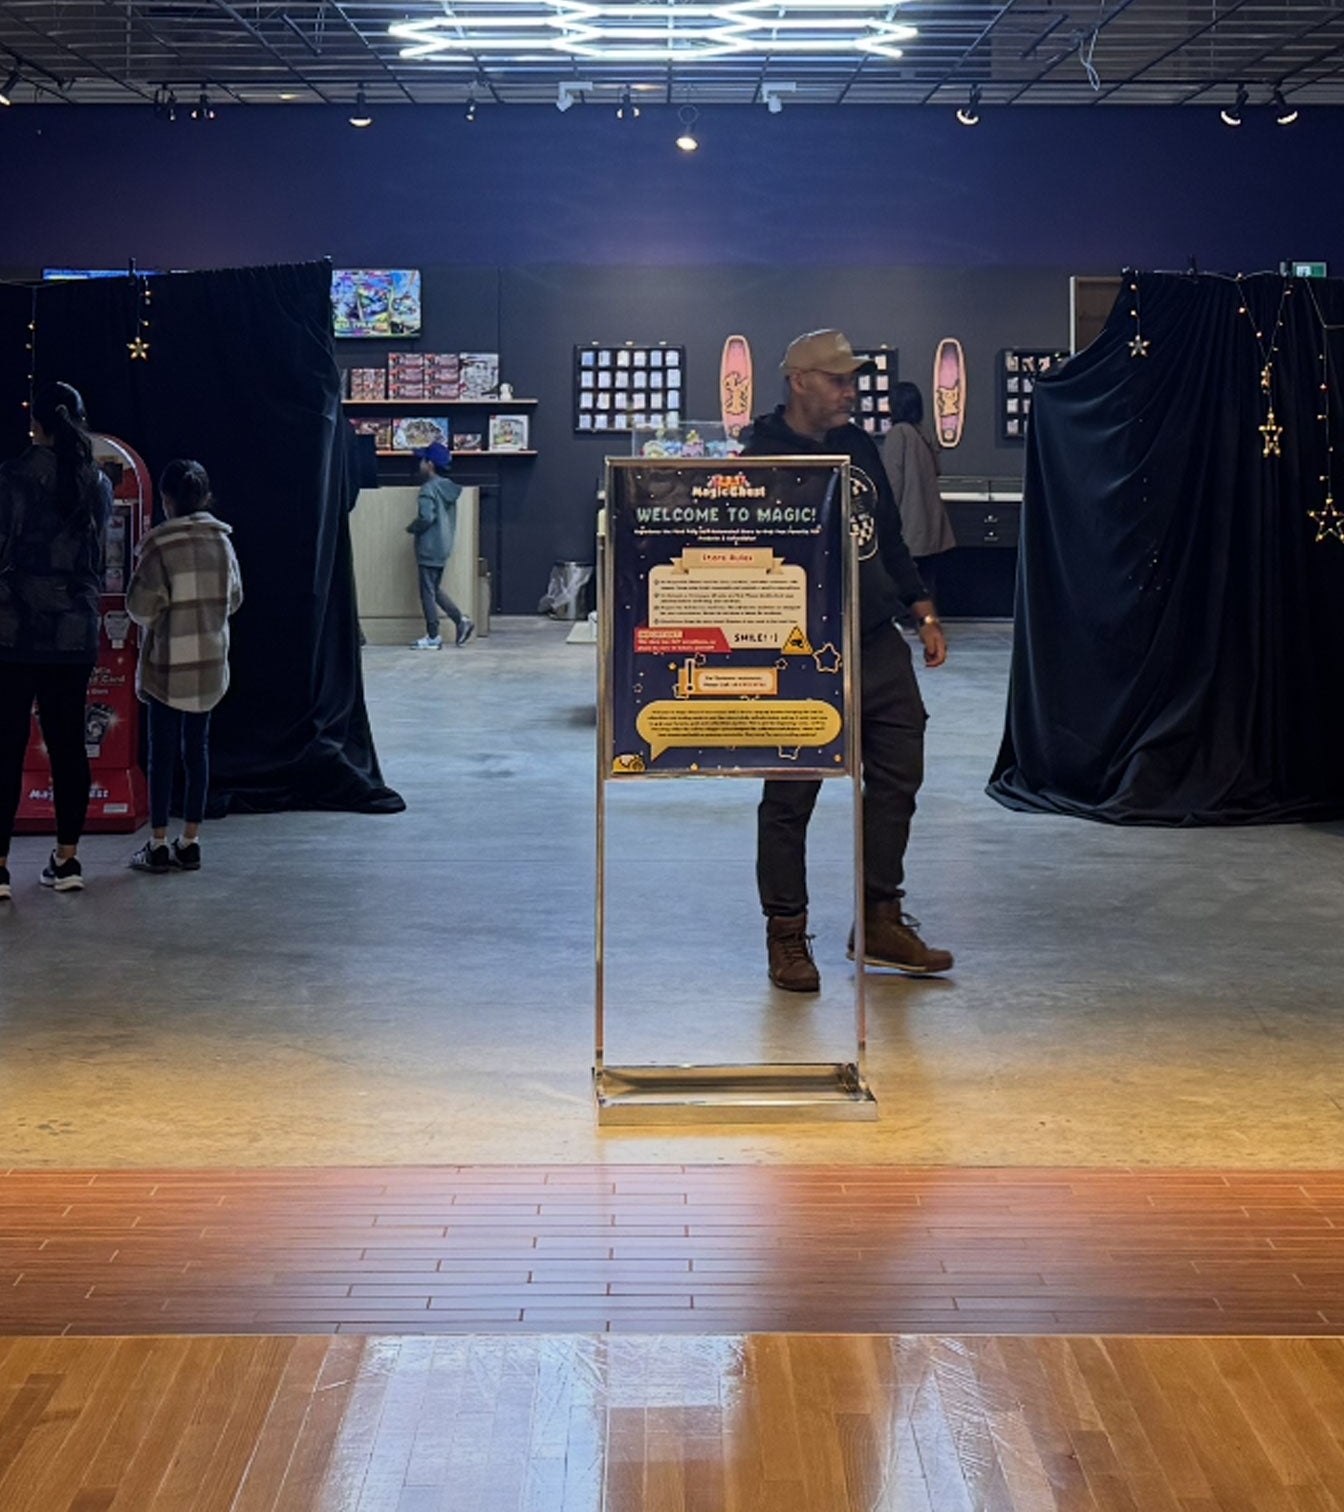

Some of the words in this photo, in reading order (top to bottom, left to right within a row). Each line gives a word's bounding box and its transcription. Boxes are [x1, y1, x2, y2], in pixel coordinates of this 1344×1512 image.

[636, 506, 720, 522] WELCOME
[727, 506, 750, 522] TO
[757, 506, 817, 522] MAGIC!
